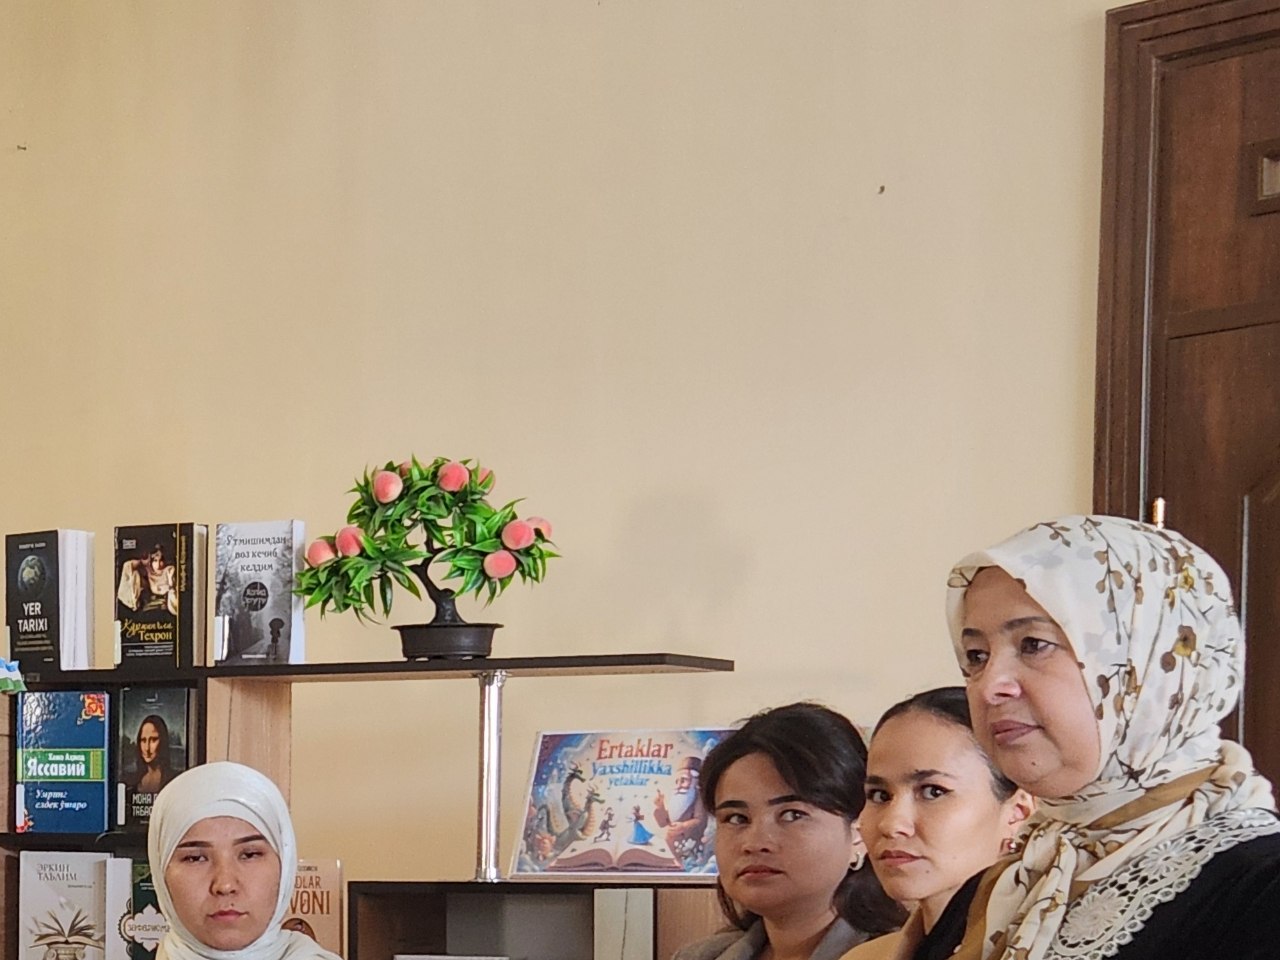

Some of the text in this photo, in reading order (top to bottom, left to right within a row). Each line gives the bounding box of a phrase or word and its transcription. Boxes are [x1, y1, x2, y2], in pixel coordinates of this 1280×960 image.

[22, 602, 42, 616] YER
[17, 618, 48, 632] TARIXI
[596, 737, 674, 760] Ertaklar
[27, 757, 86, 777] Яссавий
[294, 875, 322, 889] DLAR
[290, 890, 330, 915] VONI
